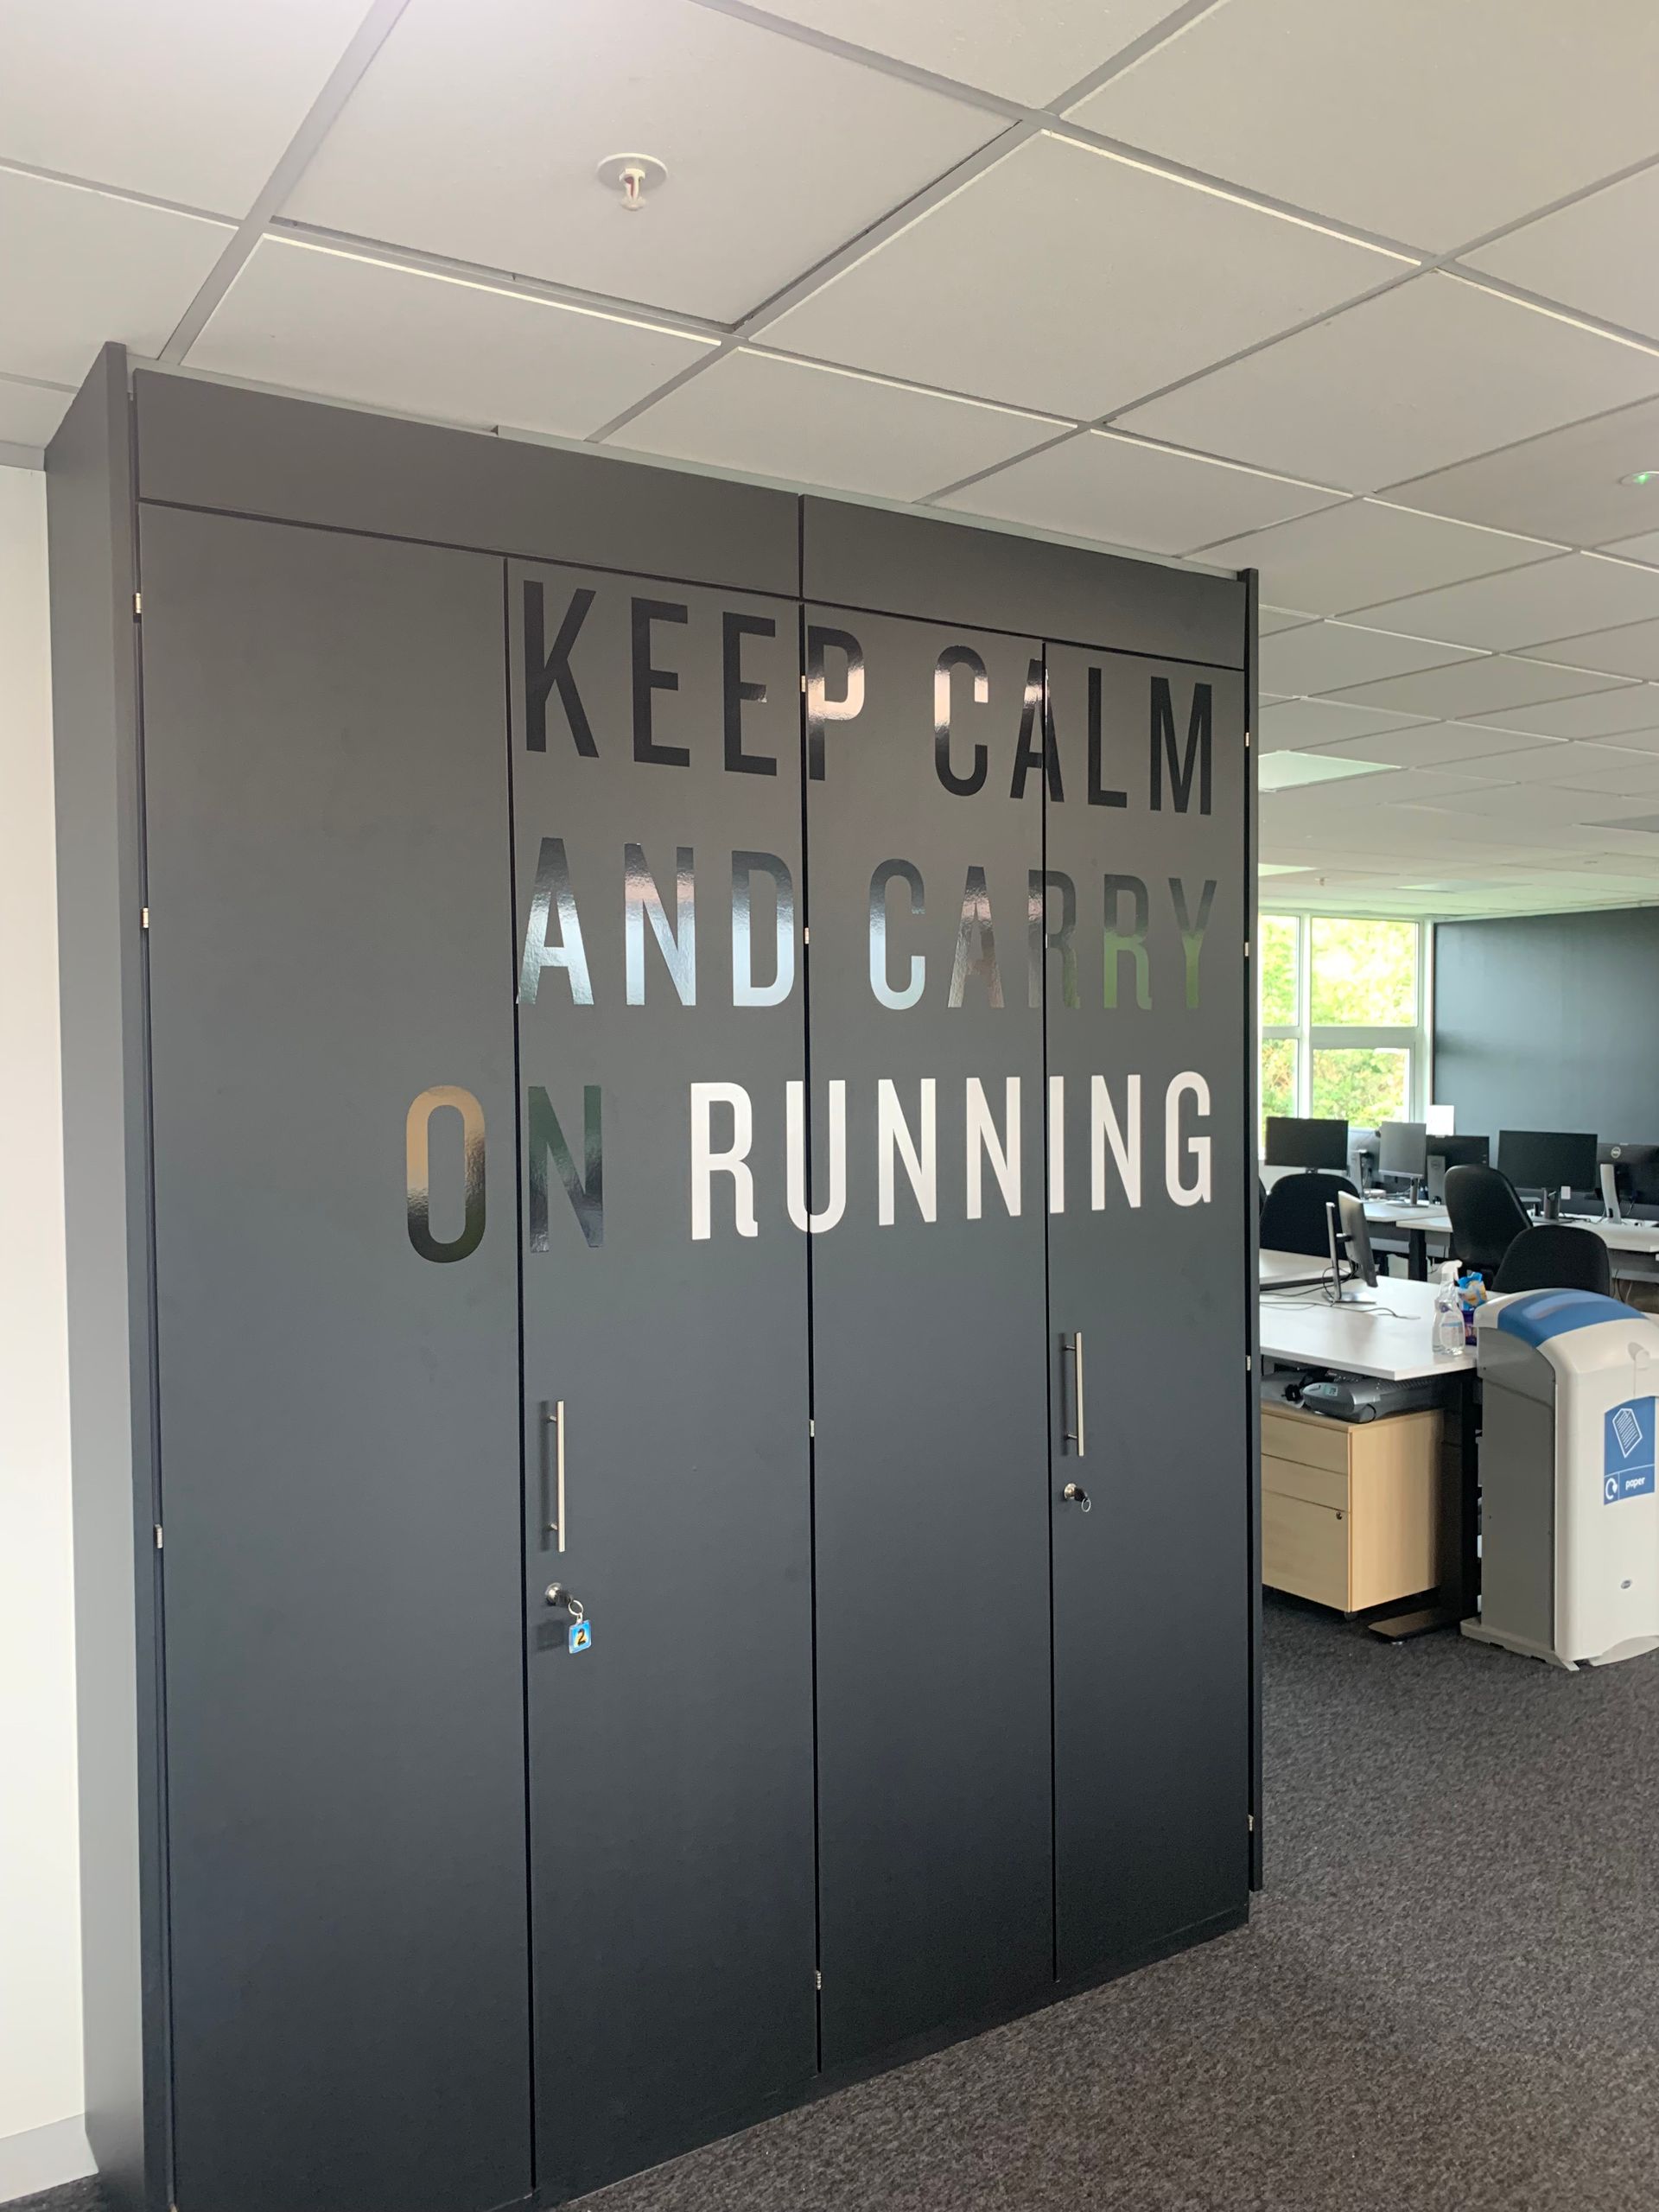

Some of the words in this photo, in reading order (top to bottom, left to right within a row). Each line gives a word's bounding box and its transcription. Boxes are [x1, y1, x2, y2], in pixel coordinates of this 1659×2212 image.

[523, 580, 864, 780] KEEP
[934, 645, 1212, 815] CALM
[517, 836, 795, 1007] AND
[869, 859, 1217, 1010] CARRY
[405, 1085, 605, 1262] ON
[690, 1071, 1211, 1239] RUNNING
[1625, 1477, 1645, 1491] paper
[577, 1628, 587, 1645] 2
